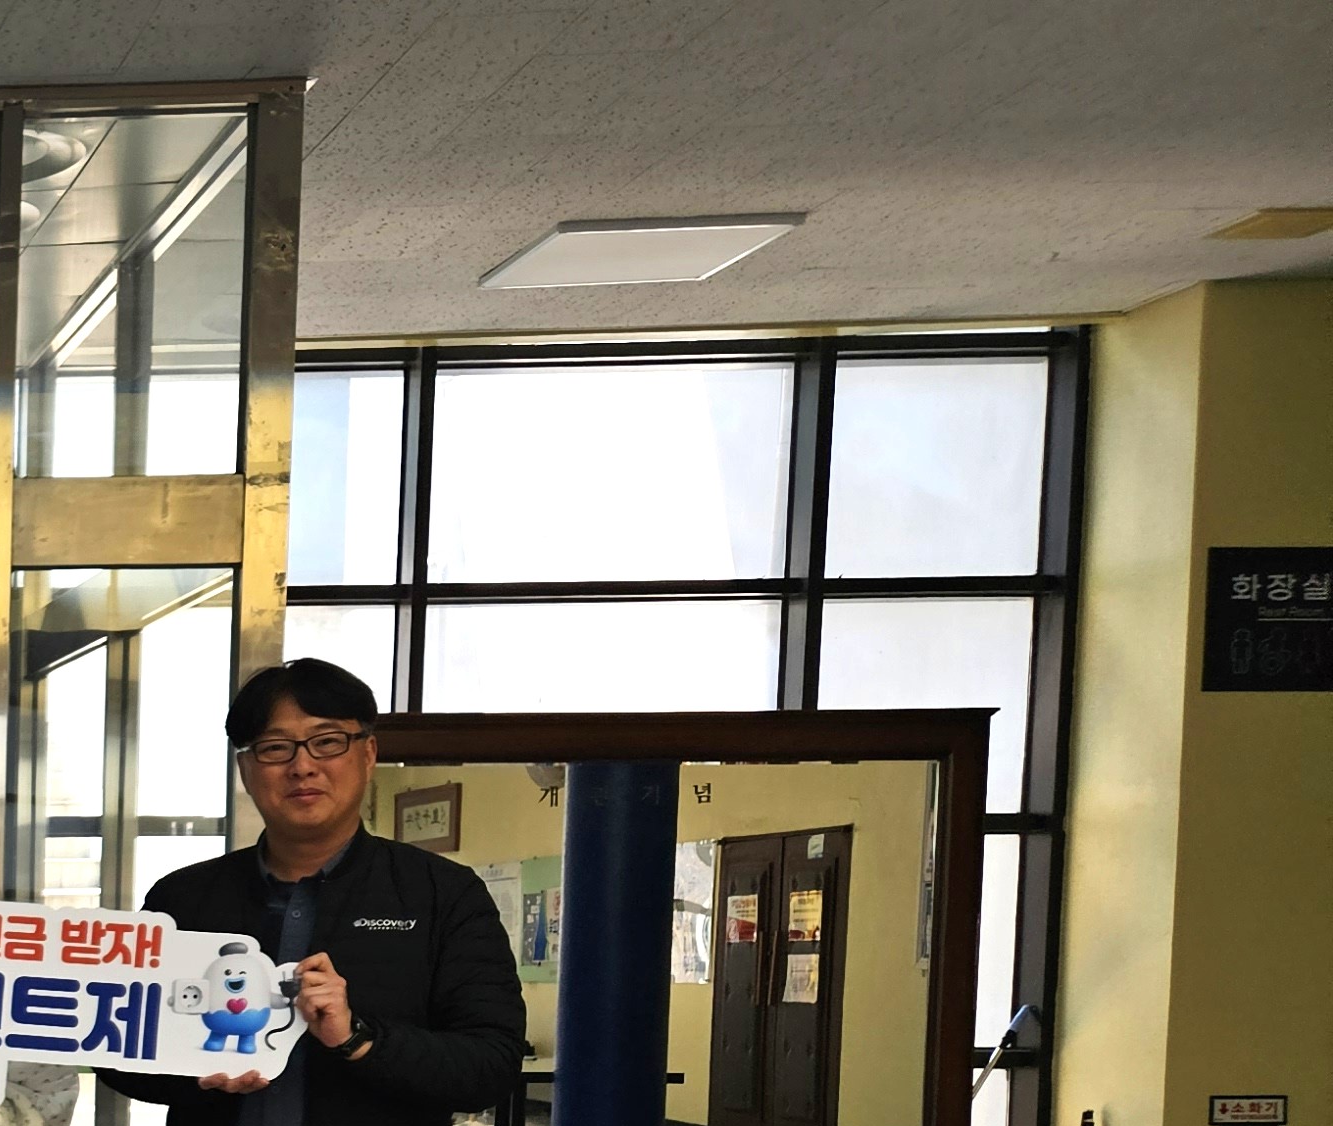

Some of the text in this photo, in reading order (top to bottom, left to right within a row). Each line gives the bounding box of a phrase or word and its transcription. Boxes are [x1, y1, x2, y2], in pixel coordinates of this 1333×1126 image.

[1231, 572, 1330, 602] 화장실
[60, 918, 163, 969] 받자!
[1231, 1102, 1279, 1114] 소화기
